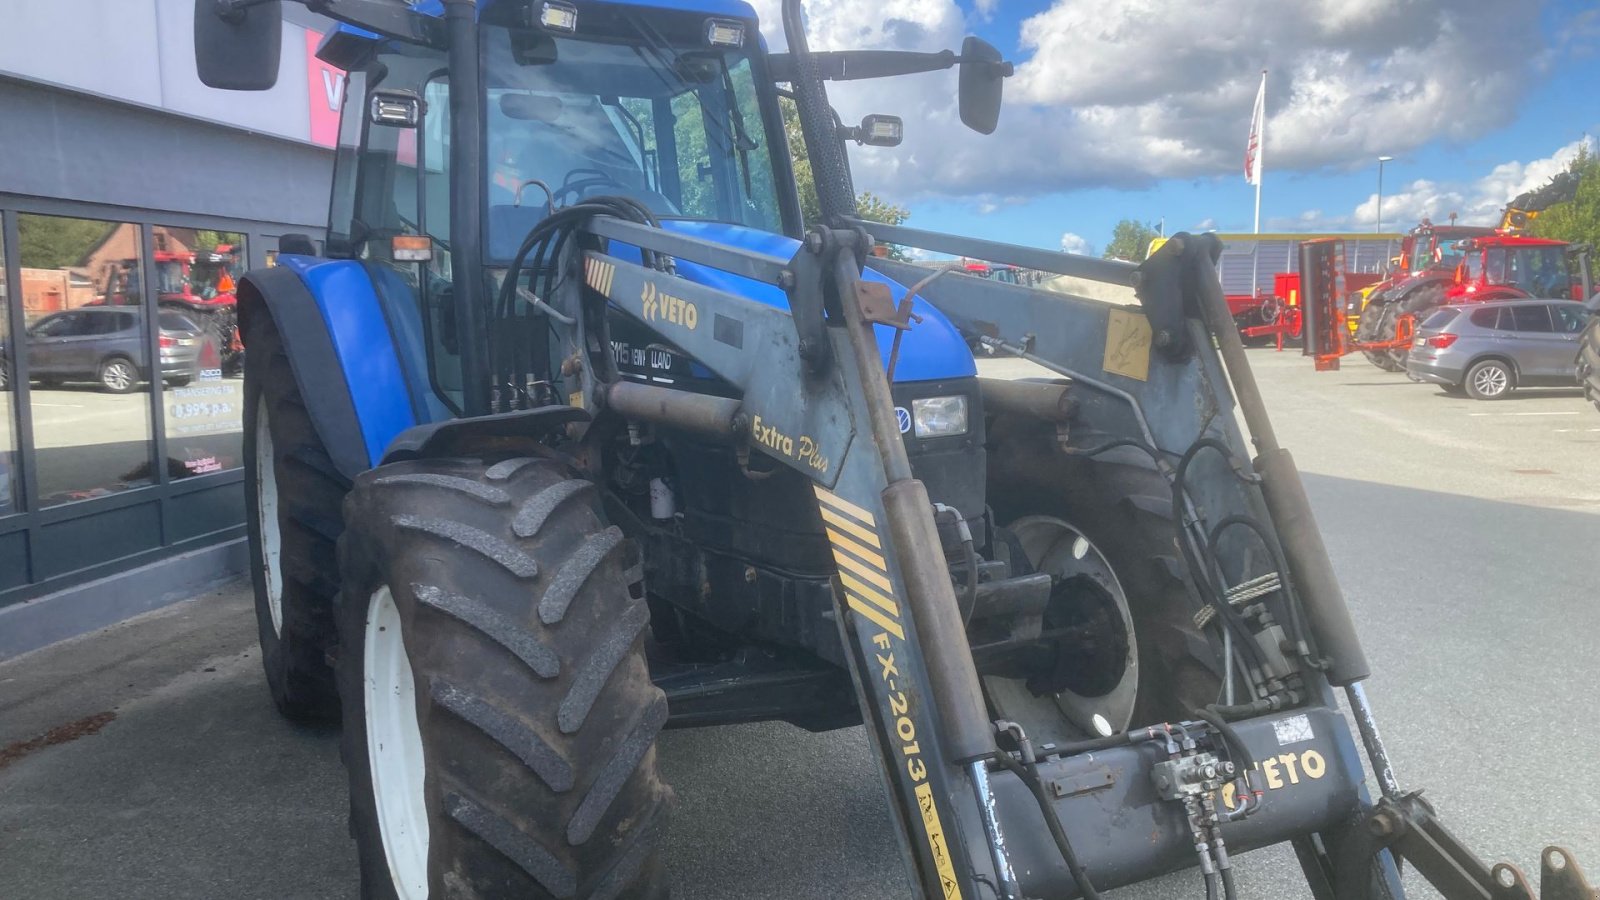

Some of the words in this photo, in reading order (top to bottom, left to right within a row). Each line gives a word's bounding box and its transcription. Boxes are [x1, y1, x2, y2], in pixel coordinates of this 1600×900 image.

[658, 294, 698, 330] VETO
[753, 415, 793, 456] Extra
[798, 435, 828, 472] Plus
[872, 632, 927, 782] FX-2013
